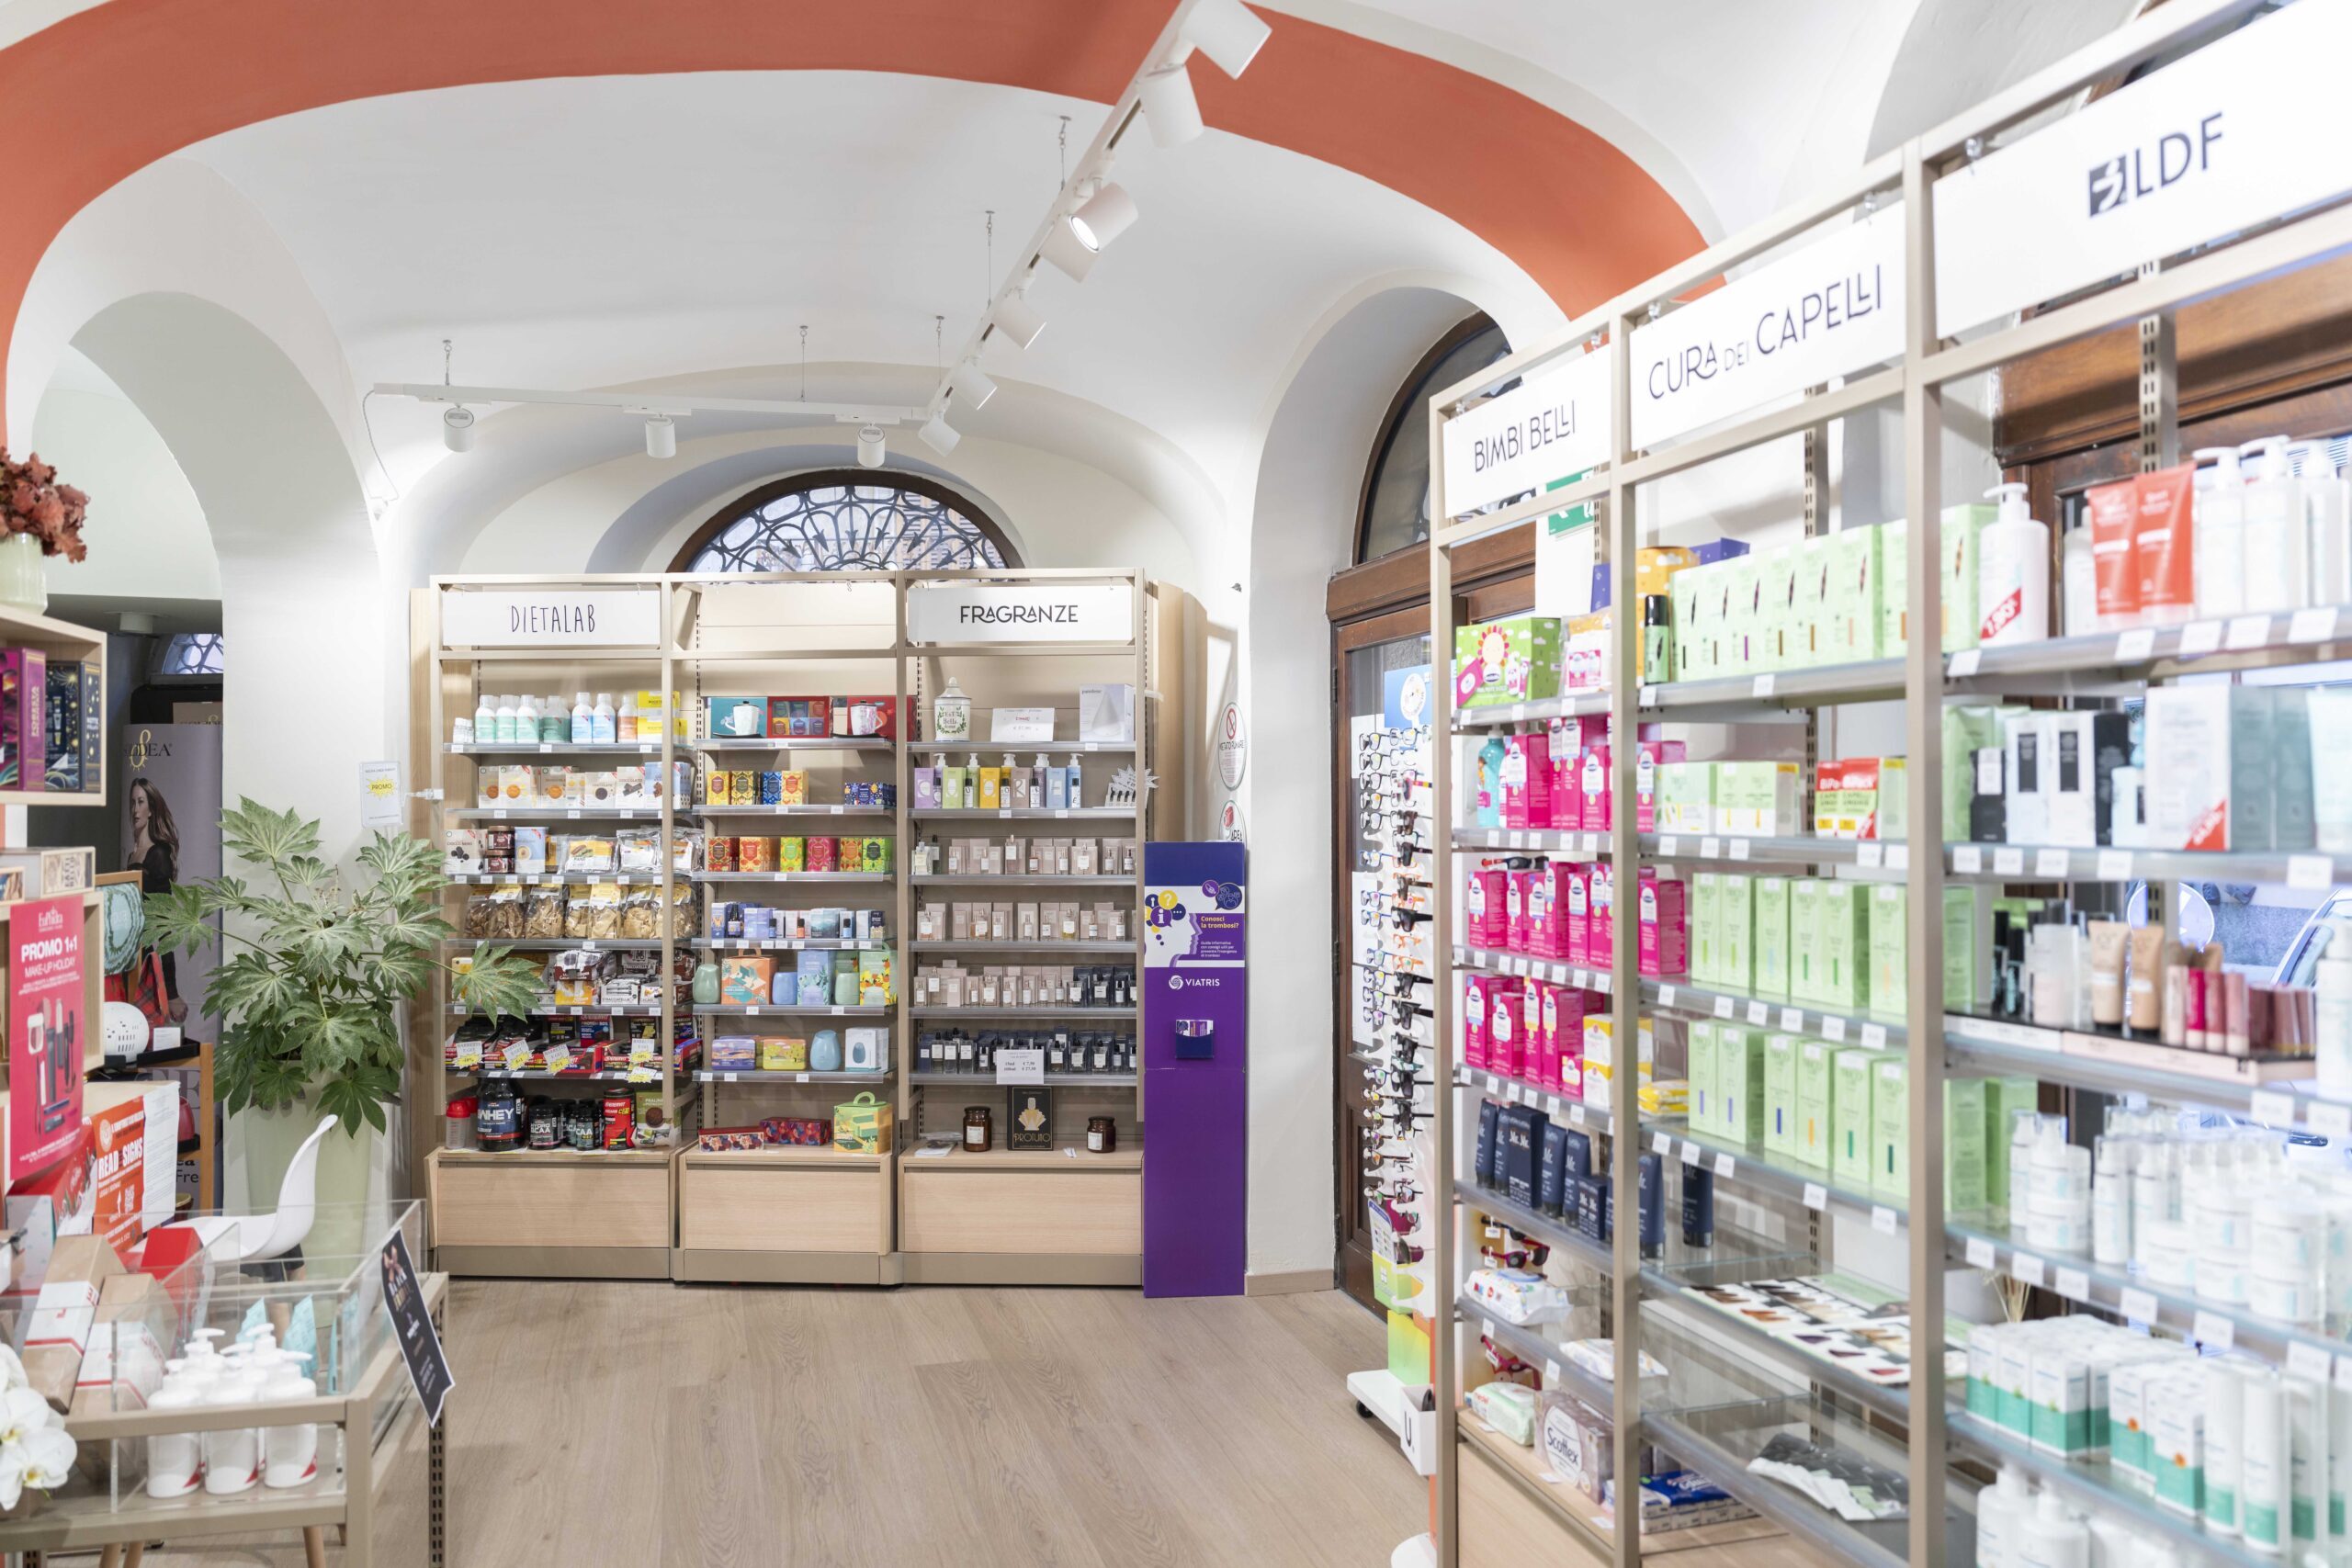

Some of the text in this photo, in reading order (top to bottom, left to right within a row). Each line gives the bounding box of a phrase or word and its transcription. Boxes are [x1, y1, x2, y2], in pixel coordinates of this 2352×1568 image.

[2135, 112, 2223, 198] LDF
[1649, 264, 1882, 400] CURA DEI CAPELLI
[1474, 400, 1576, 473] BIMBI BELLI
[511, 604, 595, 633] DIETALAB
[959, 604, 1079, 624] FRAGRANZE
[21, 934, 78, 964] PROMO 1+1
[1185, 978, 1220, 987] VIATRIS
[478, 1108, 514, 1121] WHEY
[97, 1150, 119, 1180] READ
[122, 1137, 143, 1168] SIGNS
[1546, 1427, 1579, 1466] Scottex
